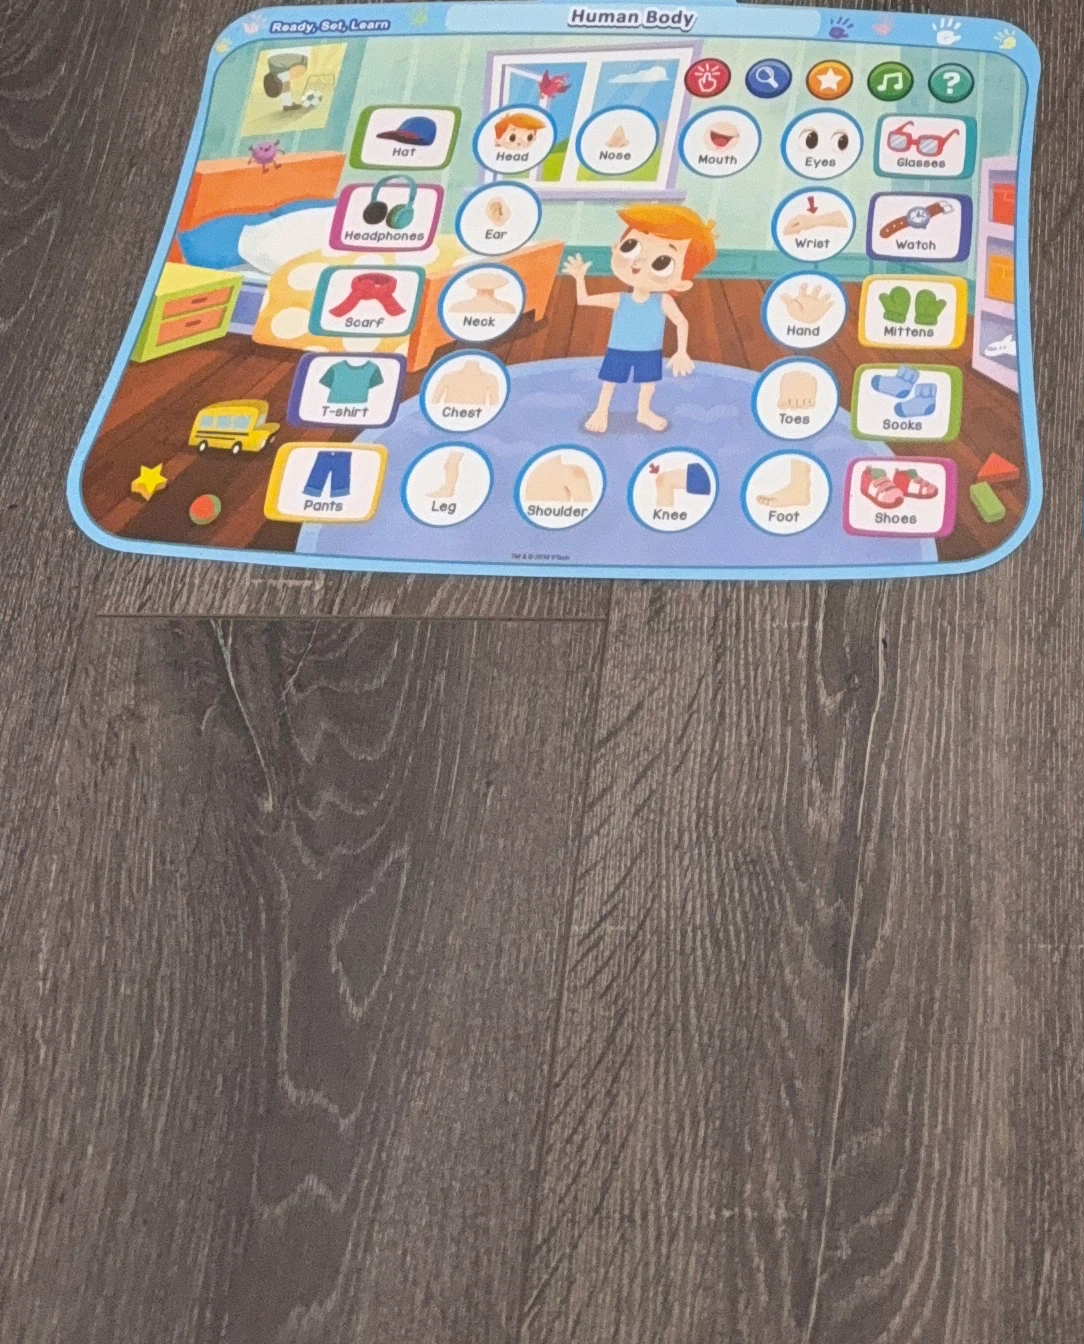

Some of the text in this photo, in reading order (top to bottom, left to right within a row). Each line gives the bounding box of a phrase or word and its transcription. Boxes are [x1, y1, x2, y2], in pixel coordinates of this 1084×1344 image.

[572, 10, 695, 29] Human Body
[271, 20, 389, 35] Ready, Set, Learn
[392, 147, 416, 158] Hat
[496, 150, 529, 162] Head
[598, 150, 632, 161] Nose
[698, 154, 738, 166] Mouth
[805, 157, 836, 168] Eyes
[896, 158, 946, 169] Glasses
[344, 230, 425, 244] Headphones
[484, 229, 507, 240] Ear
[794, 238, 830, 250] Wrist
[896, 239, 936, 252] Watch
[344, 316, 385, 328] Scarf
[462, 316, 496, 328] Neck
[786, 325, 820, 338] Hand
[884, 326, 934, 338] Mittens
[321, 406, 369, 419] T-shirt
[442, 406, 482, 419] Chest
[778, 413, 810, 426] Toes
[882, 419, 923, 432] Socks
[304, 500, 342, 513] Pants
[431, 500, 456, 515] Leg
[527, 504, 589, 518] Shoulder
[652, 508, 688, 522] Knee
[768, 510, 800, 524] Foot
[874, 512, 918, 526] Shoes
